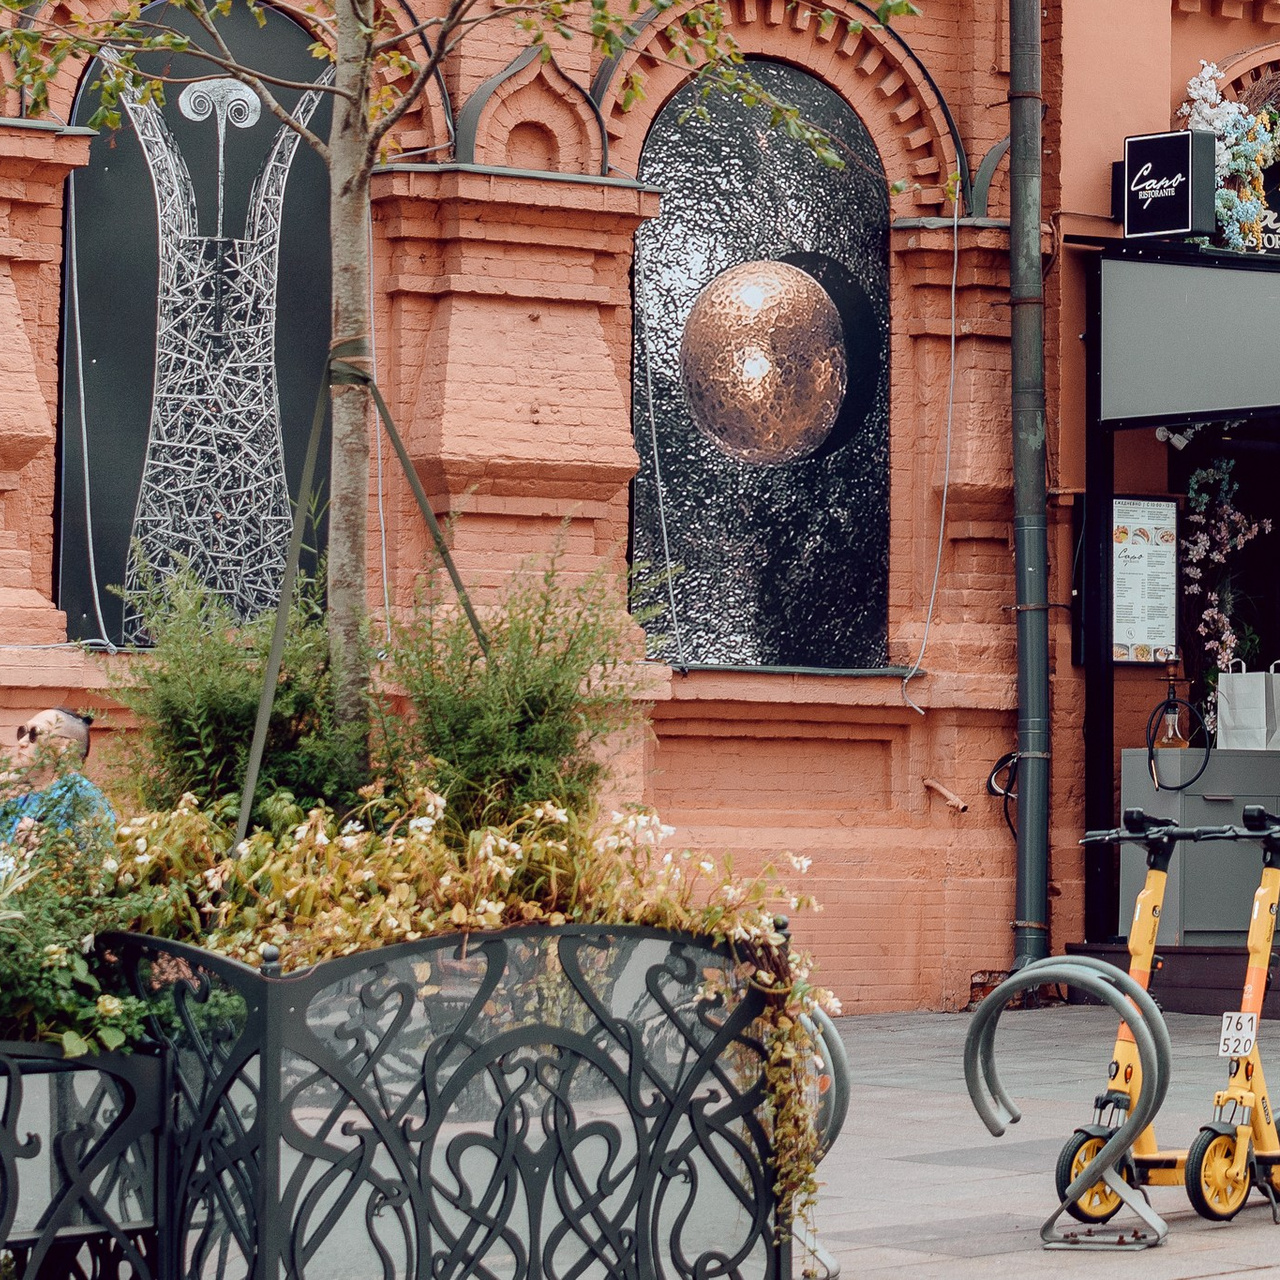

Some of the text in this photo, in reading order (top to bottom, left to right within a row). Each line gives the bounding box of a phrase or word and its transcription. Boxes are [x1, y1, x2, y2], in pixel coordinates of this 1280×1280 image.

[1131, 162, 1186, 209] Capo
[1138, 187, 1176, 200] RISTORANTE
[1225, 1015, 1254, 1032] 761
[1221, 1037, 1252, 1054] 520
